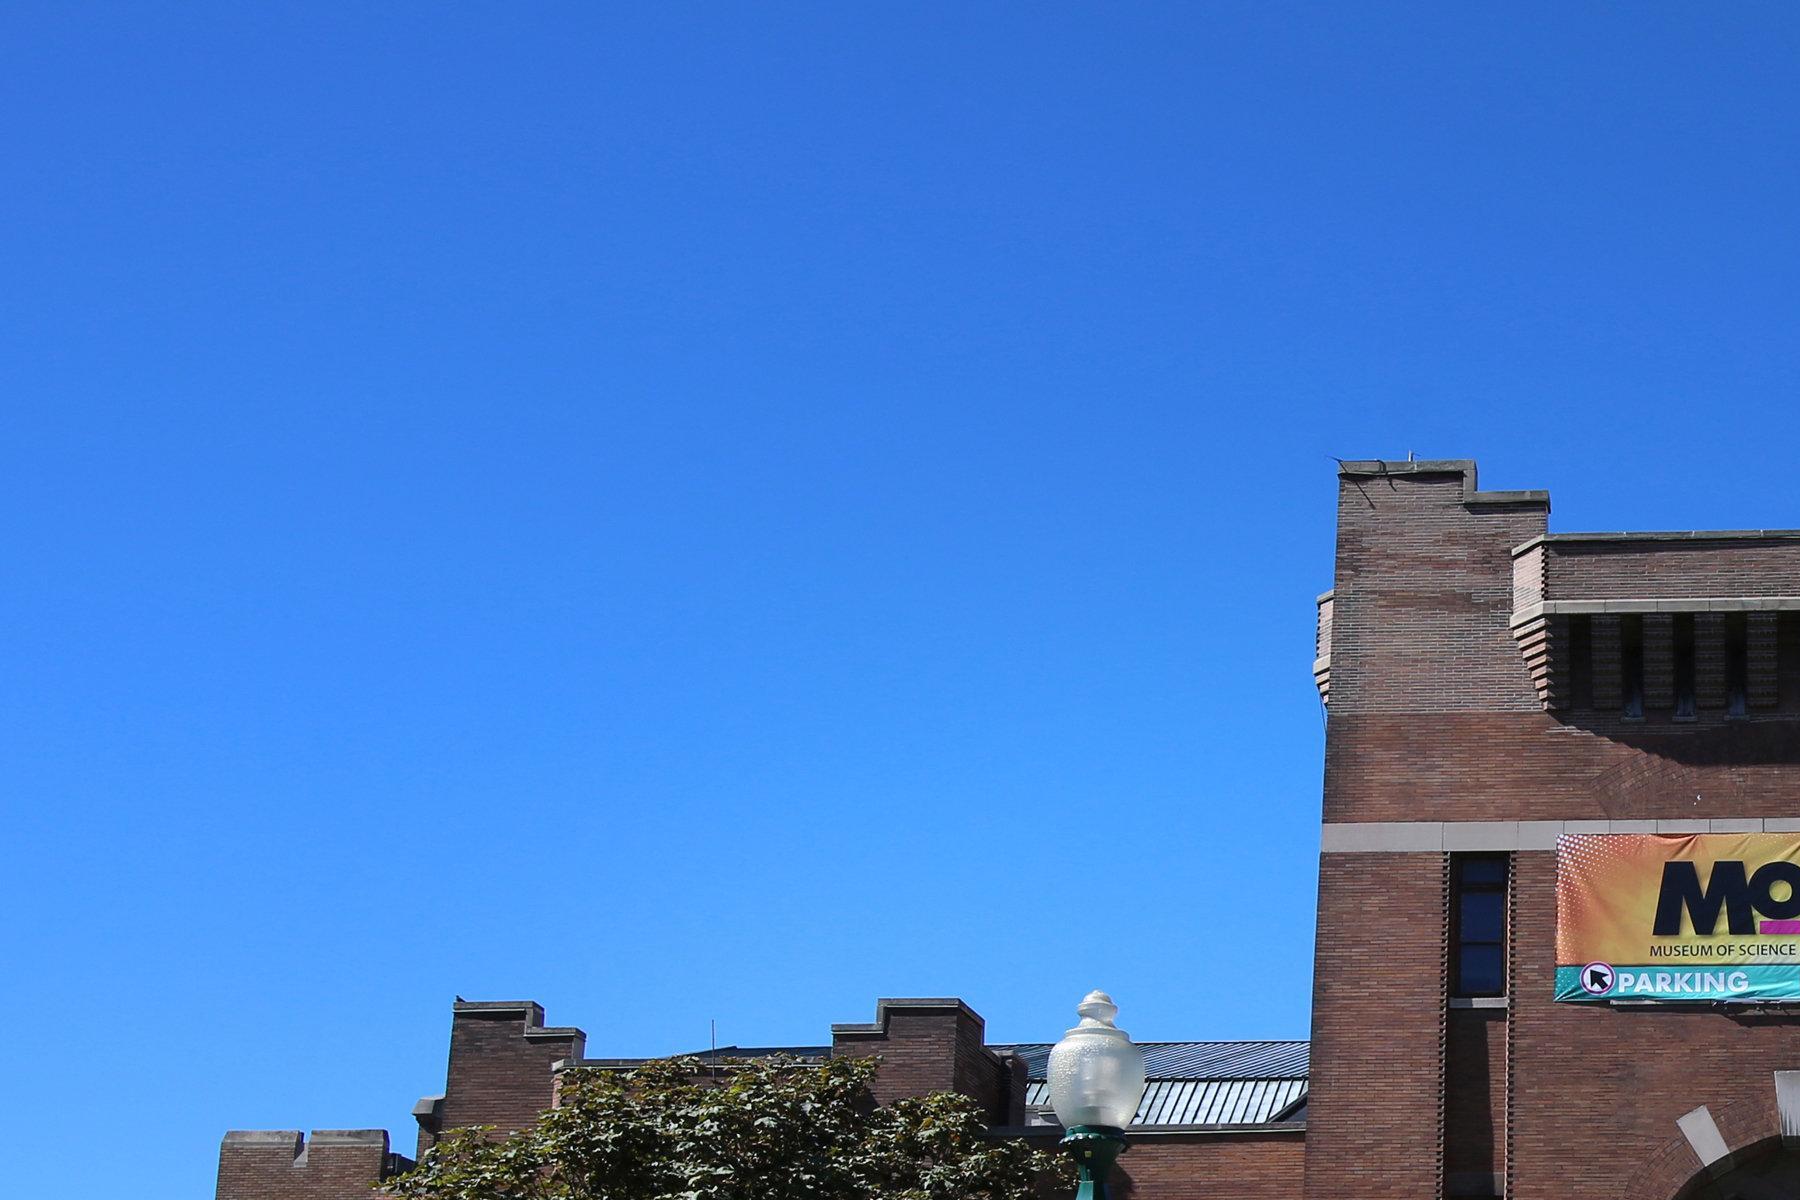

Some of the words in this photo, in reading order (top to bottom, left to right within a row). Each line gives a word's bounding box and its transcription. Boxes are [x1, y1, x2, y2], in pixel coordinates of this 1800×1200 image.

[1650, 945, 1713, 957] MUSEUM
[1716, 944, 1735, 957] OF
[1739, 944, 1796, 956] SCIENCE
[1618, 972, 1750, 993] PARKING
